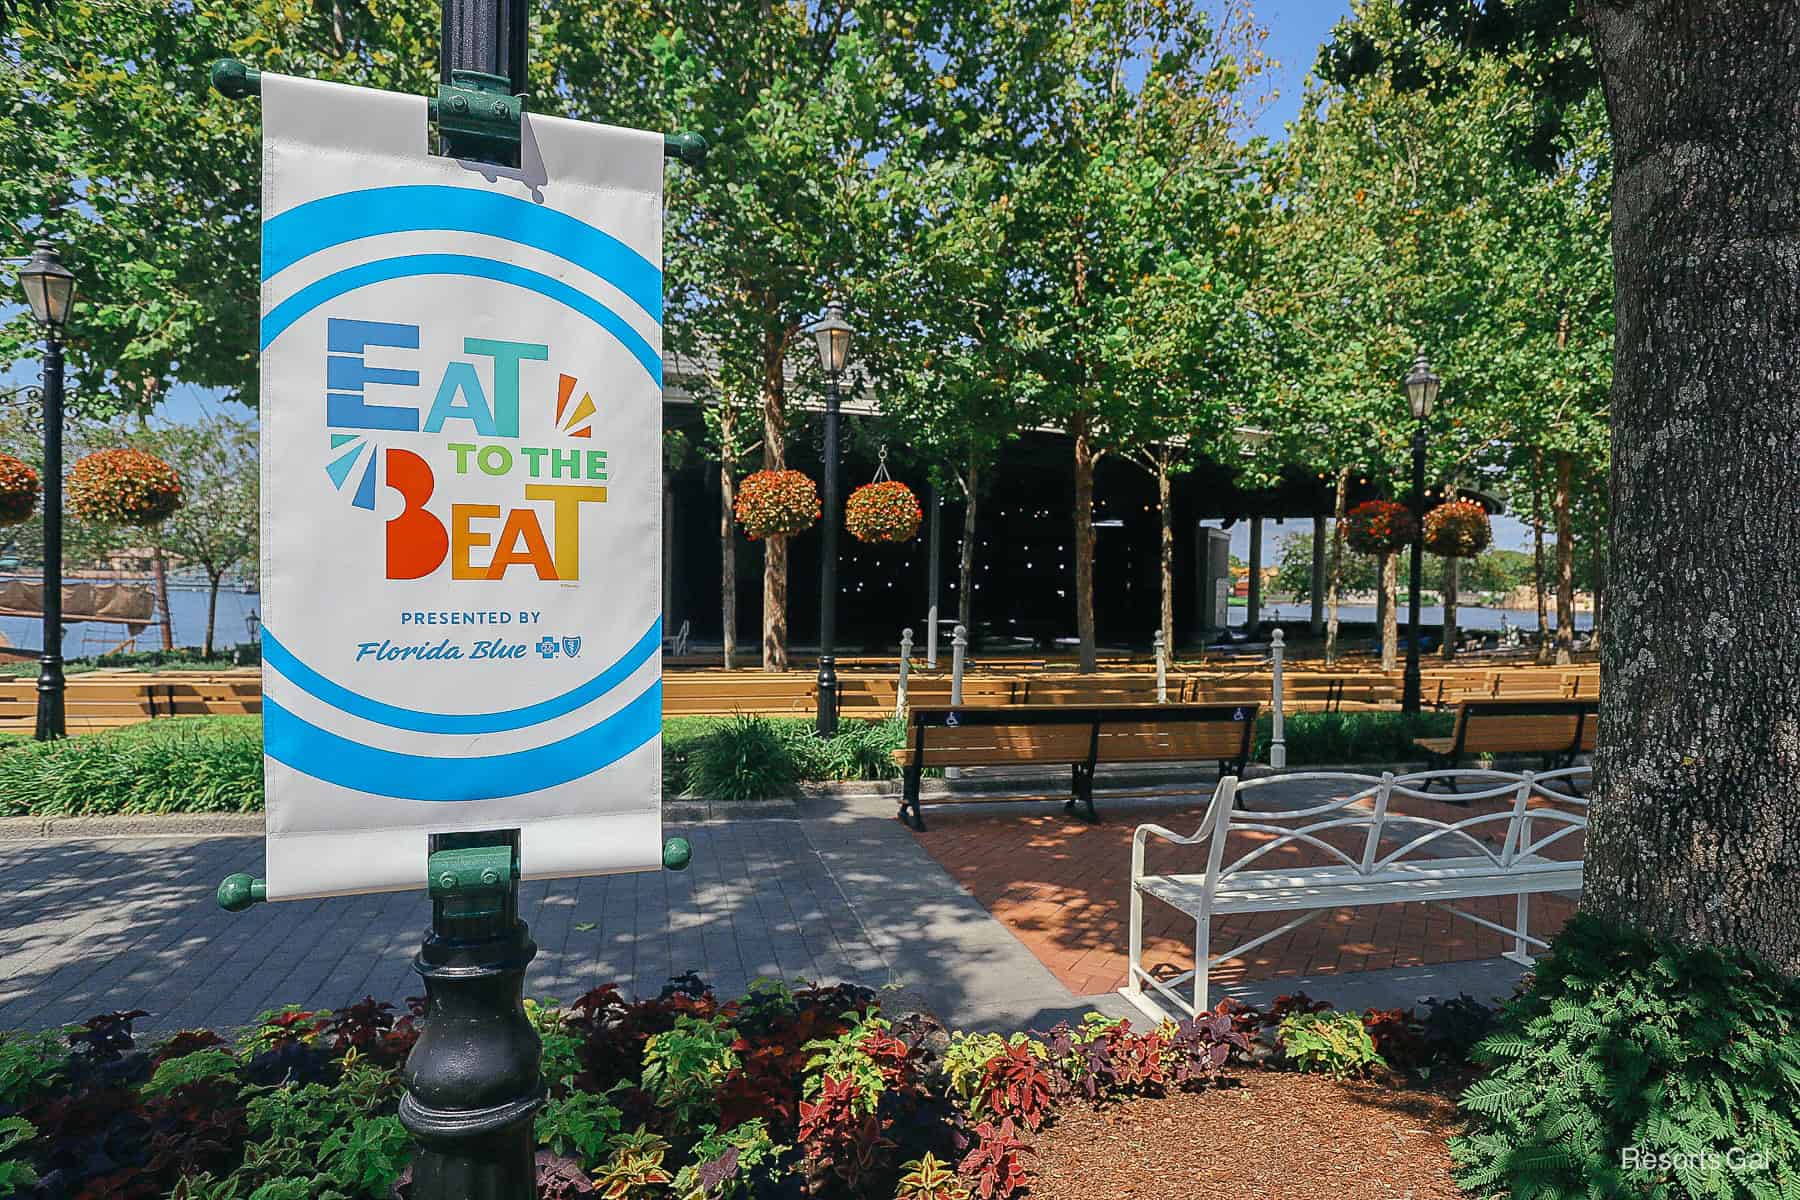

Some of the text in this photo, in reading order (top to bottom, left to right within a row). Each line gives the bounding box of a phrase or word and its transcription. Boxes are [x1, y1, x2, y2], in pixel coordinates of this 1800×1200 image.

[327, 318, 548, 438] EAT
[448, 443, 608, 480] TO THE
[386, 448, 607, 581] BEAT
[401, 611, 541, 625] PRESENTED BY
[356, 637, 527, 662] Florida Blue
